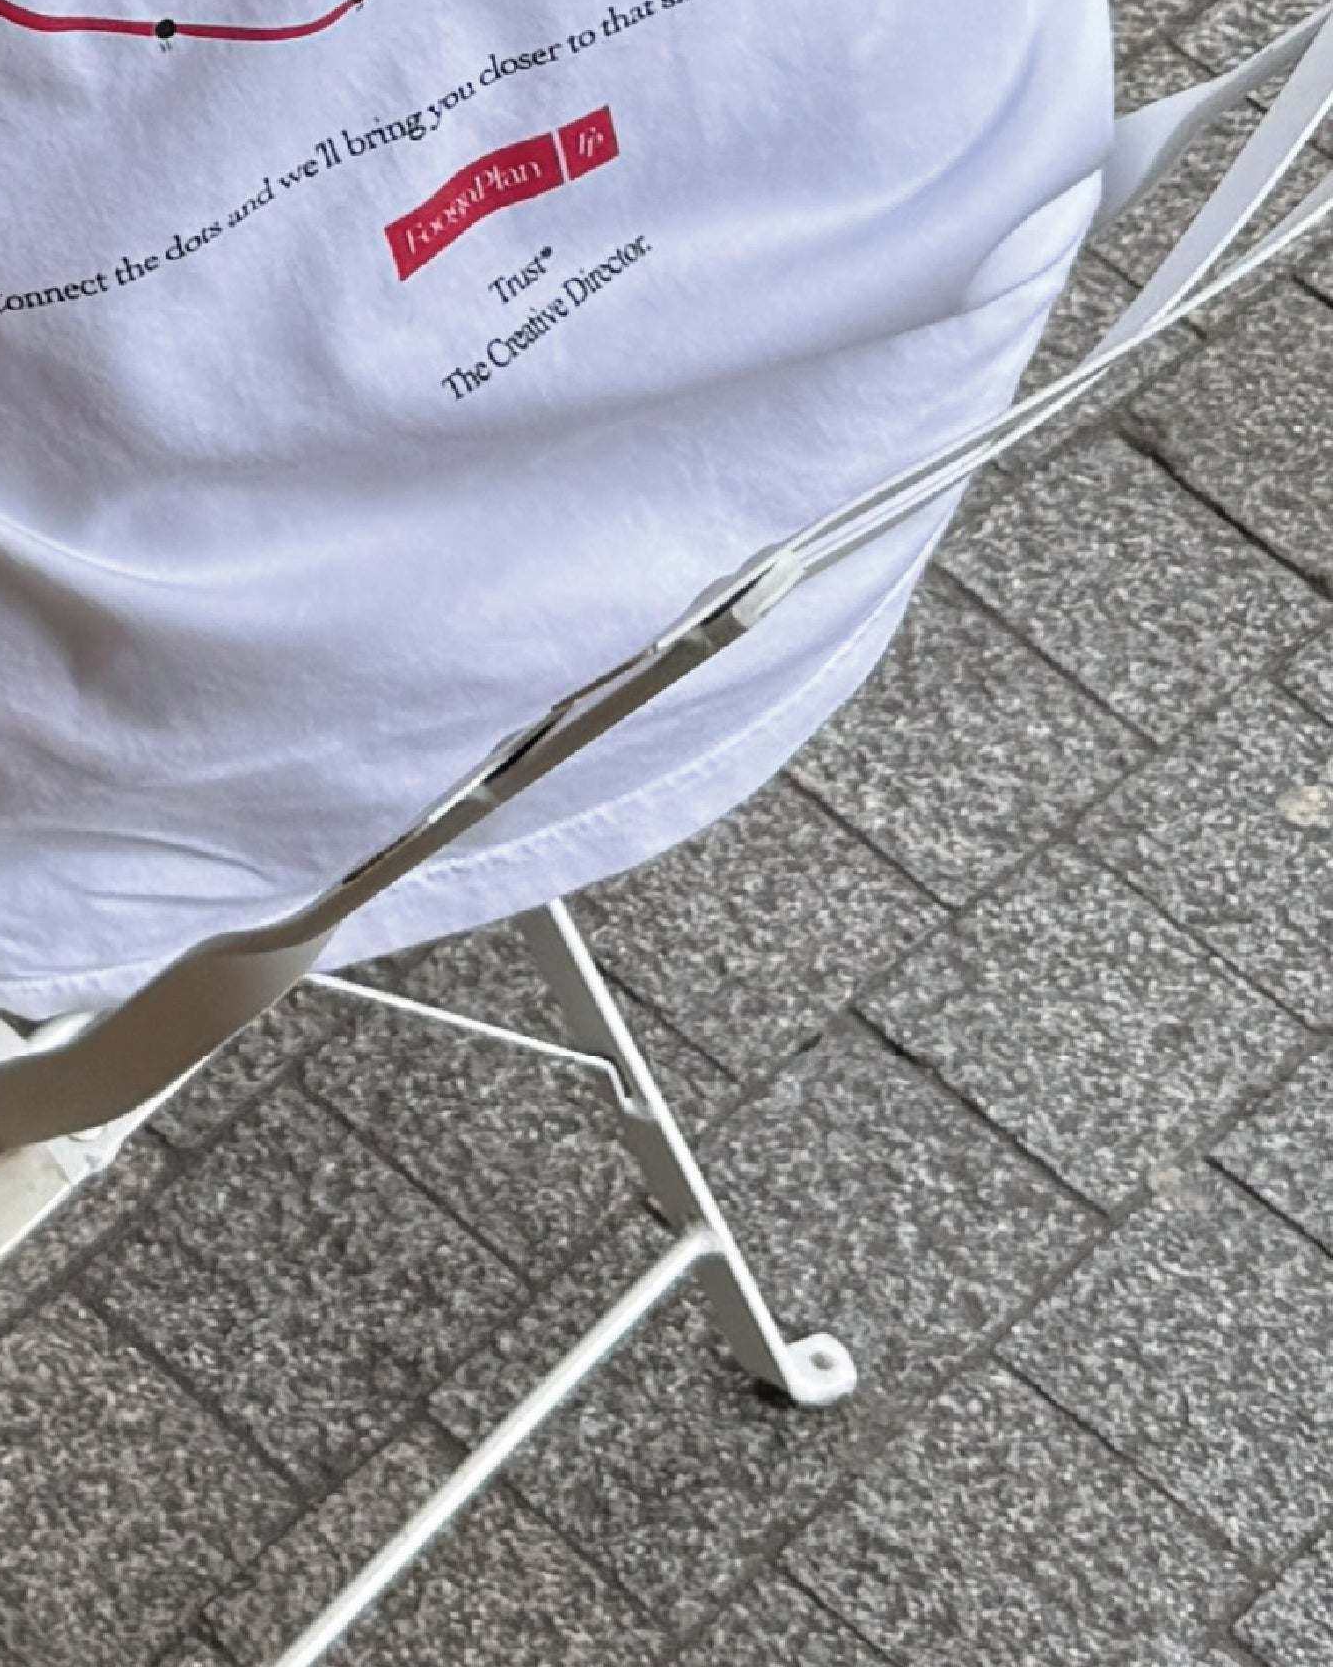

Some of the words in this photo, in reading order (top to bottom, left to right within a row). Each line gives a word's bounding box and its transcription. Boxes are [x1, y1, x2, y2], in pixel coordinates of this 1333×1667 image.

[115, 255, 160, 287] the
[166, 222, 224, 261] dots
[228, 177, 275, 228] and
[342, 111, 428, 157] bring
[427, 81, 477, 134] you
[480, 42, 563, 87] closer
[567, 29, 597, 55] to
[601, 1, 656, 38] that
[441, 361, 492, 401] The
[487, 298, 570, 368] Creative
